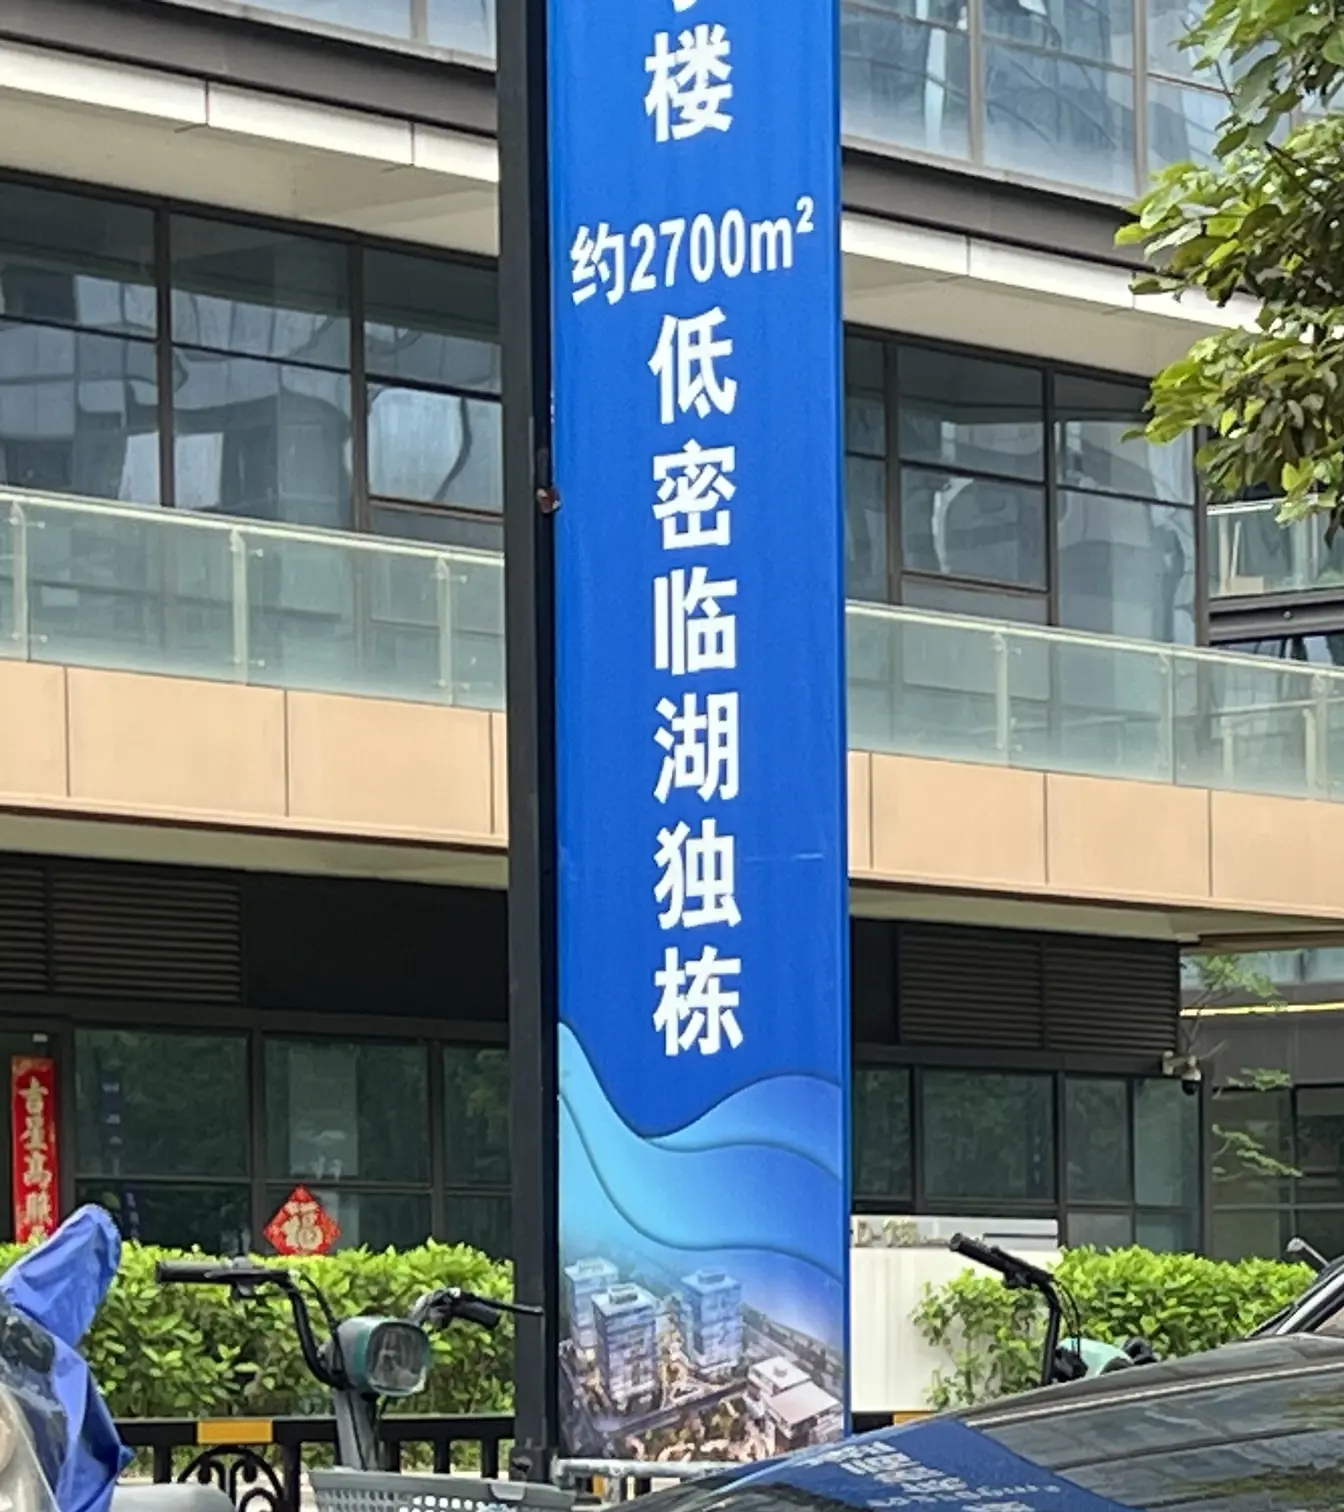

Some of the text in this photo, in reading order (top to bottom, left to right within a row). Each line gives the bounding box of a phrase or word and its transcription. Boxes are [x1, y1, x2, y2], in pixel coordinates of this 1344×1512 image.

[644, 0, 733, 142] 楼
[648, 306, 744, 1057] 低密临湖独栋
[280, 1200, 324, 1250] 福
